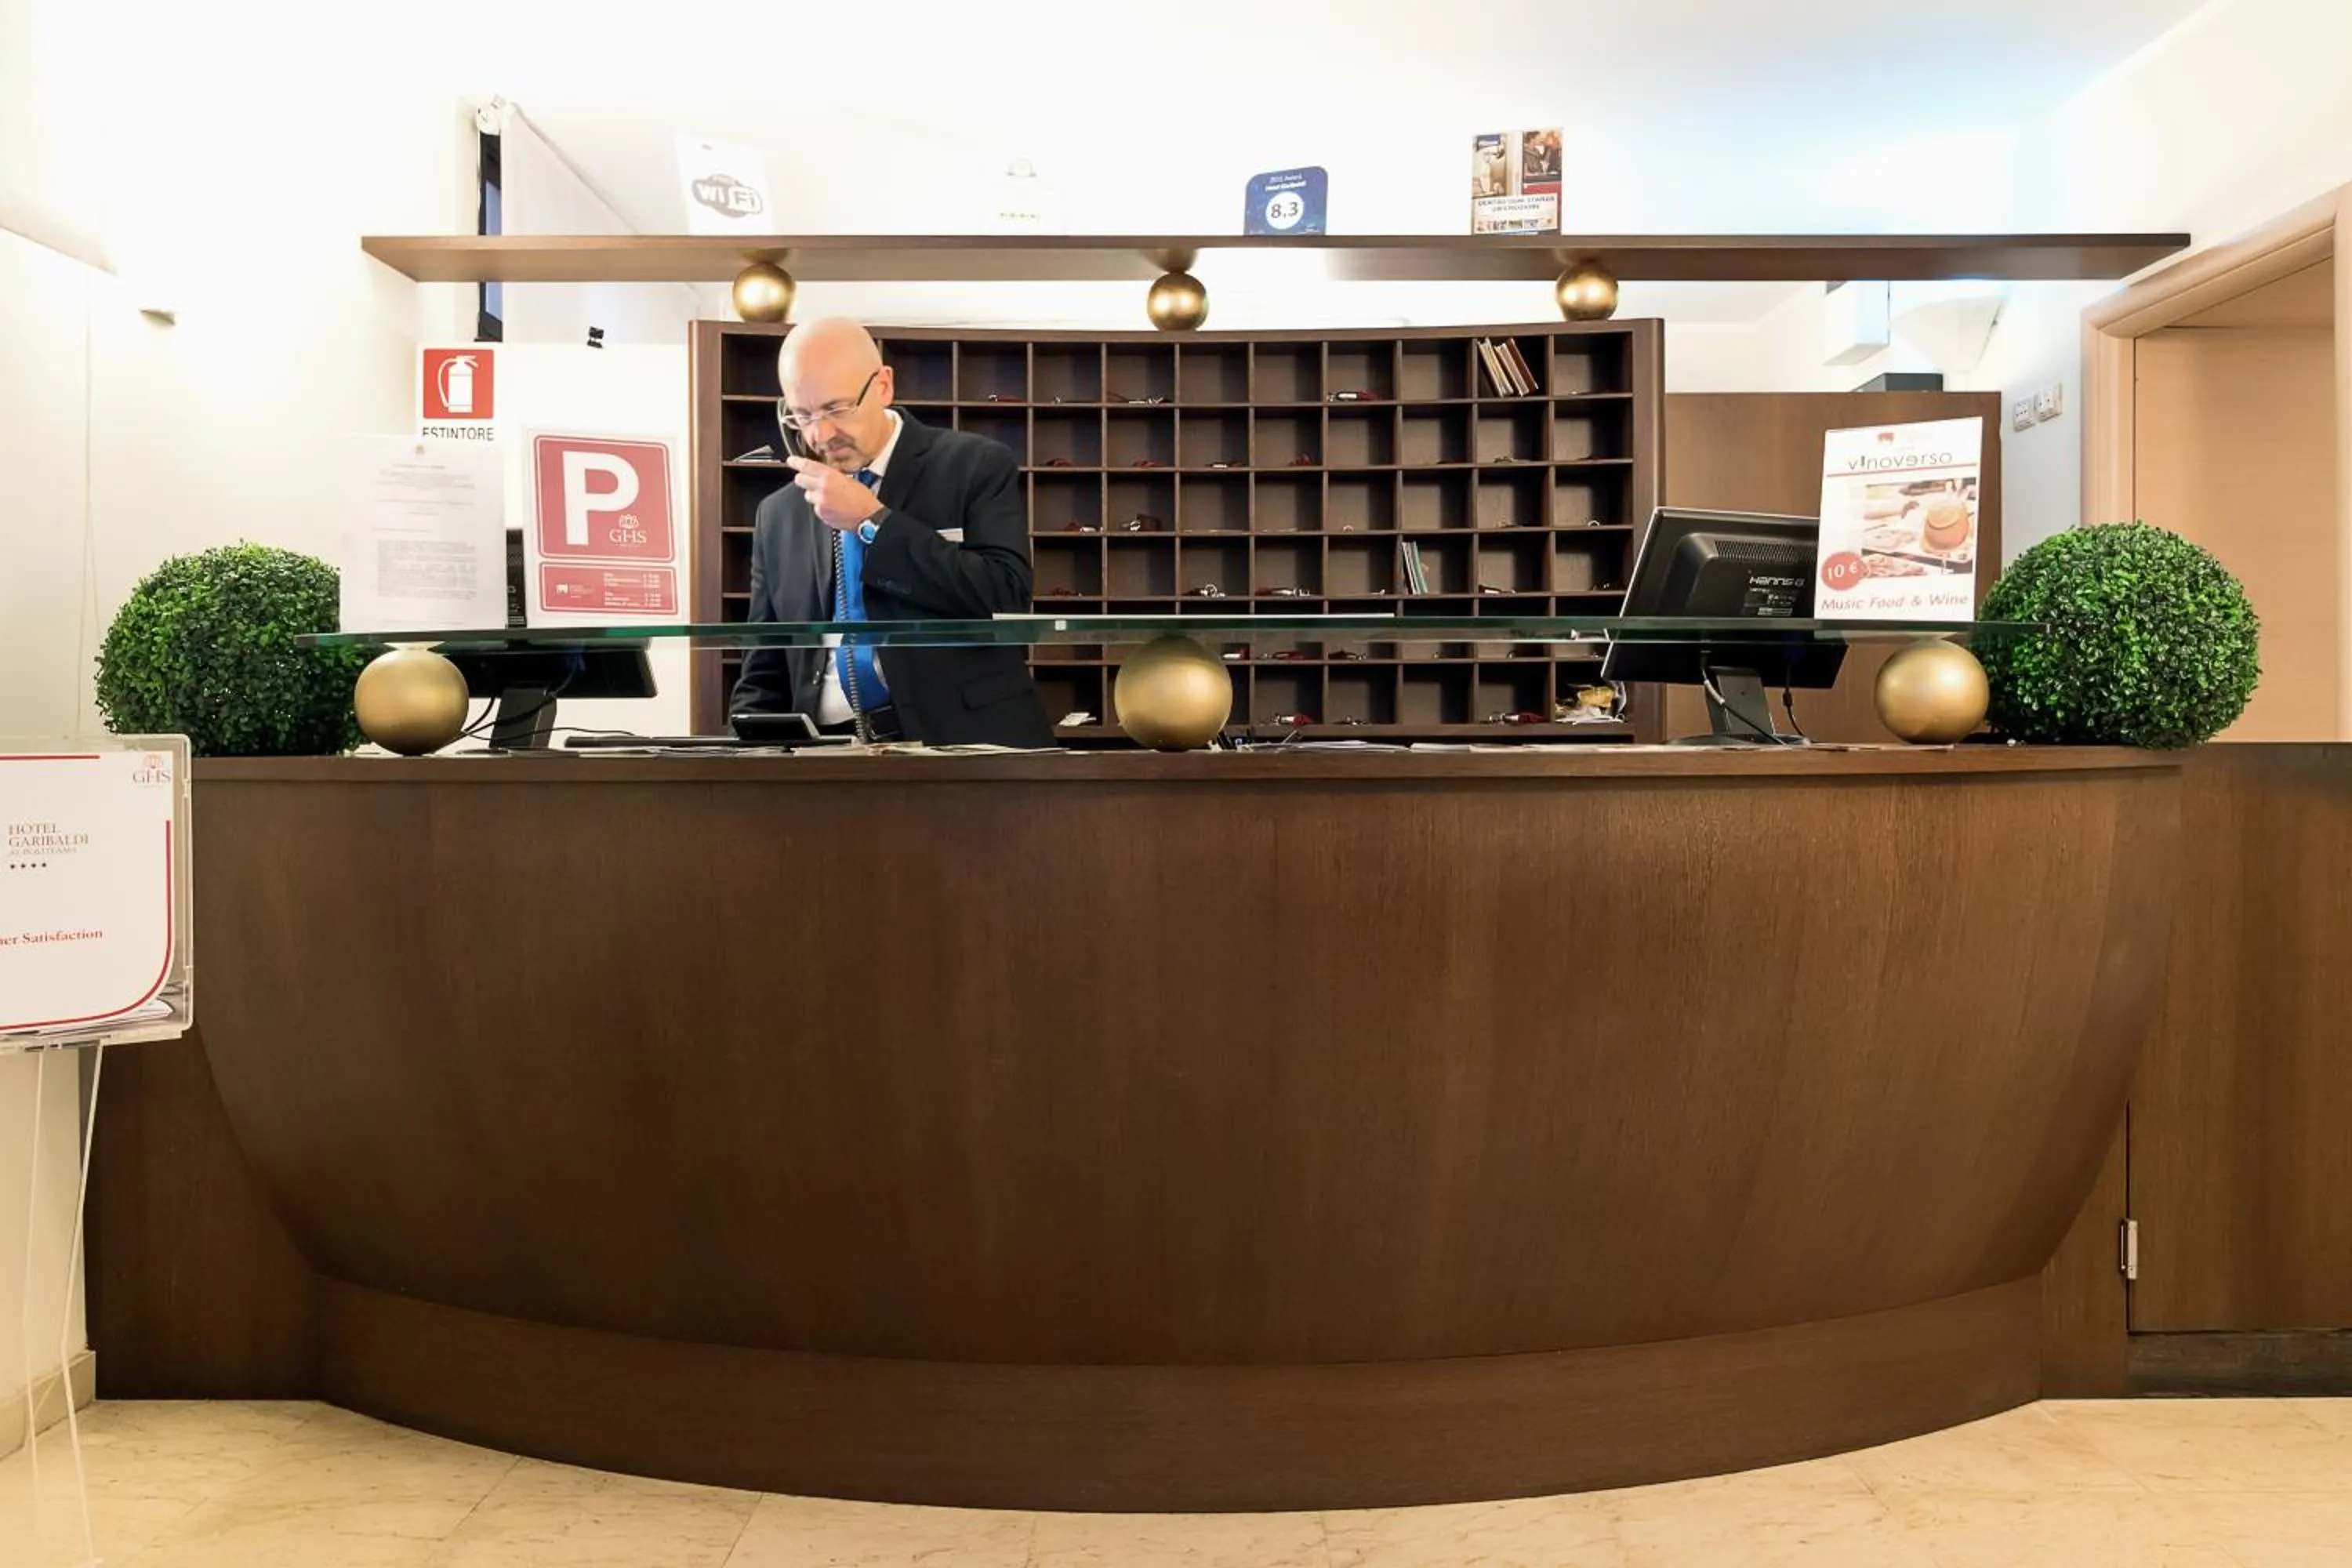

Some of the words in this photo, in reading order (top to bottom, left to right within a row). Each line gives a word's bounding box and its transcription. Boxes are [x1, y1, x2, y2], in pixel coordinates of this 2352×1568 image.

[422, 426, 495, 441] ESTINTORE
[562, 450, 639, 546] P
[608, 528, 648, 544] GHS
[1827, 564, 1846, 581] 10
[1821, 597, 1865, 611] Music
[1869, 596, 1904, 608] Food
[1911, 596, 1922, 607] &
[1929, 593, 1969, 606] Wine
[132, 770, 171, 784] GHS
[9, 822, 61, 835] HOTEL
[9, 834, 89, 848] GARIBALDI
[22, 929, 103, 944] Satisfaction
